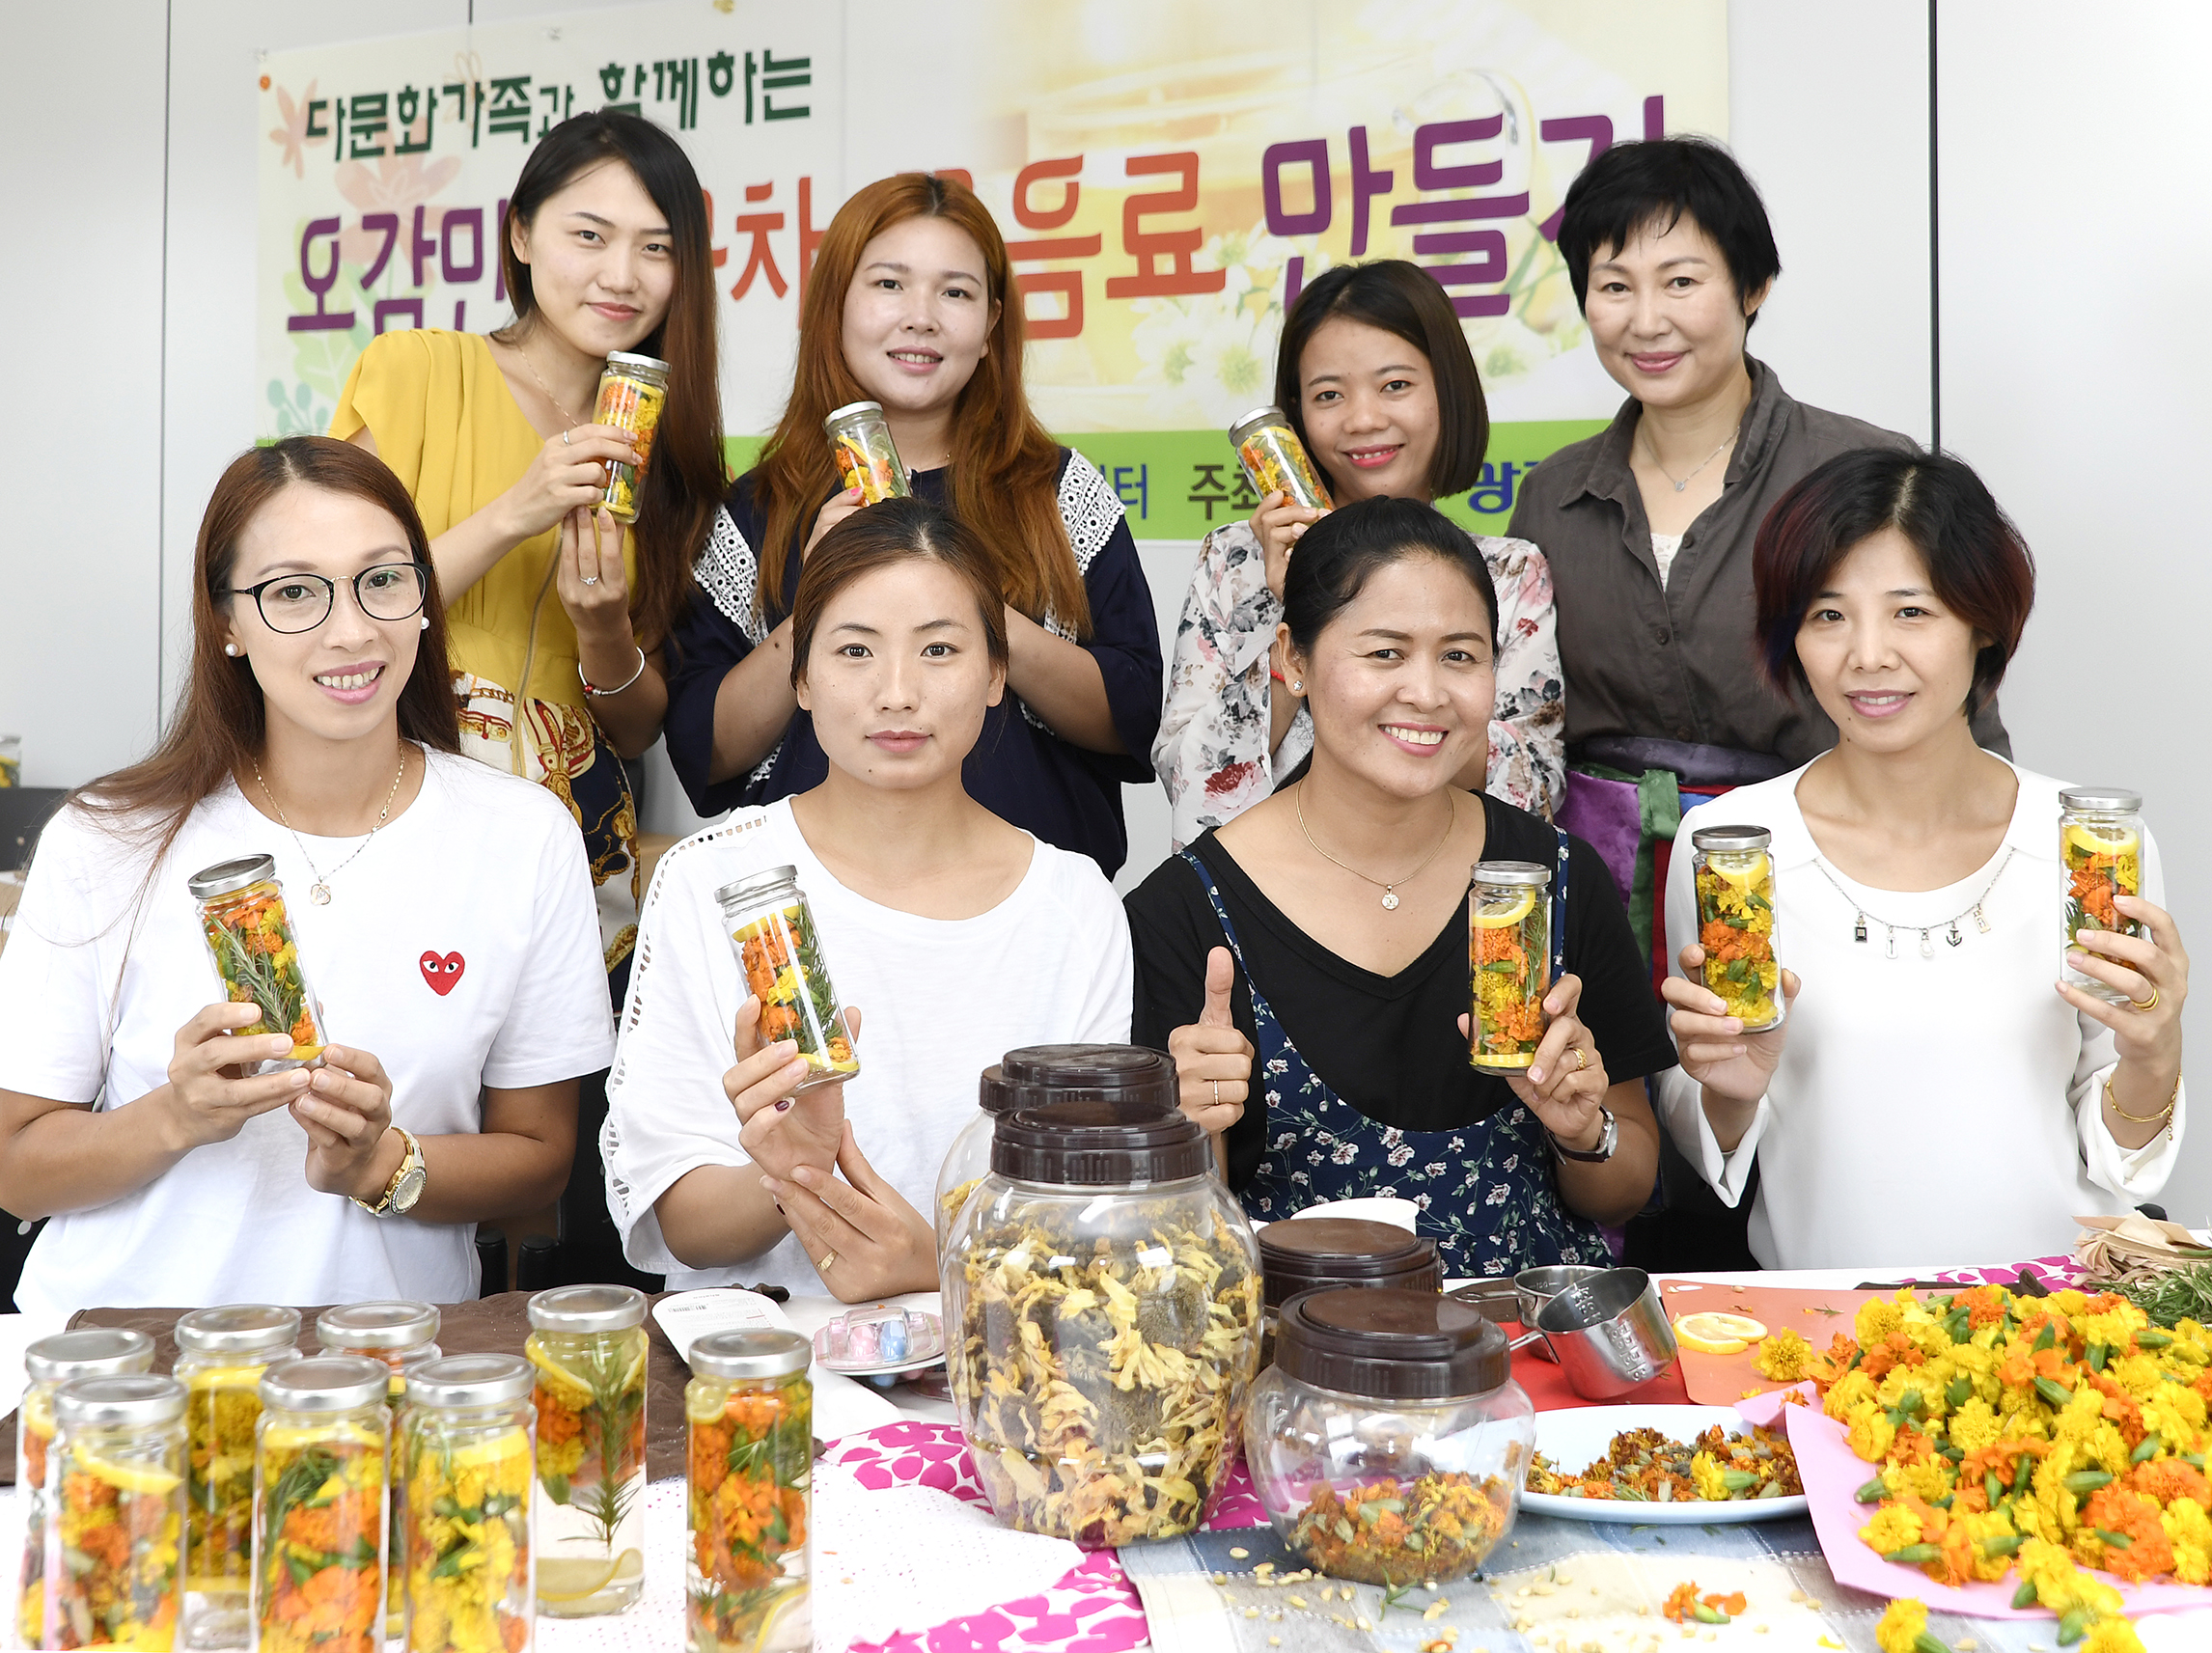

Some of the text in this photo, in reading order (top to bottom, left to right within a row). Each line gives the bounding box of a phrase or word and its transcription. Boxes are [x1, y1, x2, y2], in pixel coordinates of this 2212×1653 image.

[305, 49, 812, 161] 다문화가족과 함께하는
[703, 176, 827, 334] 차
[905, 152, 1227, 341] 음료
[1100, 462, 1147, 520] 터
[1468, 461, 1540, 514] 광
